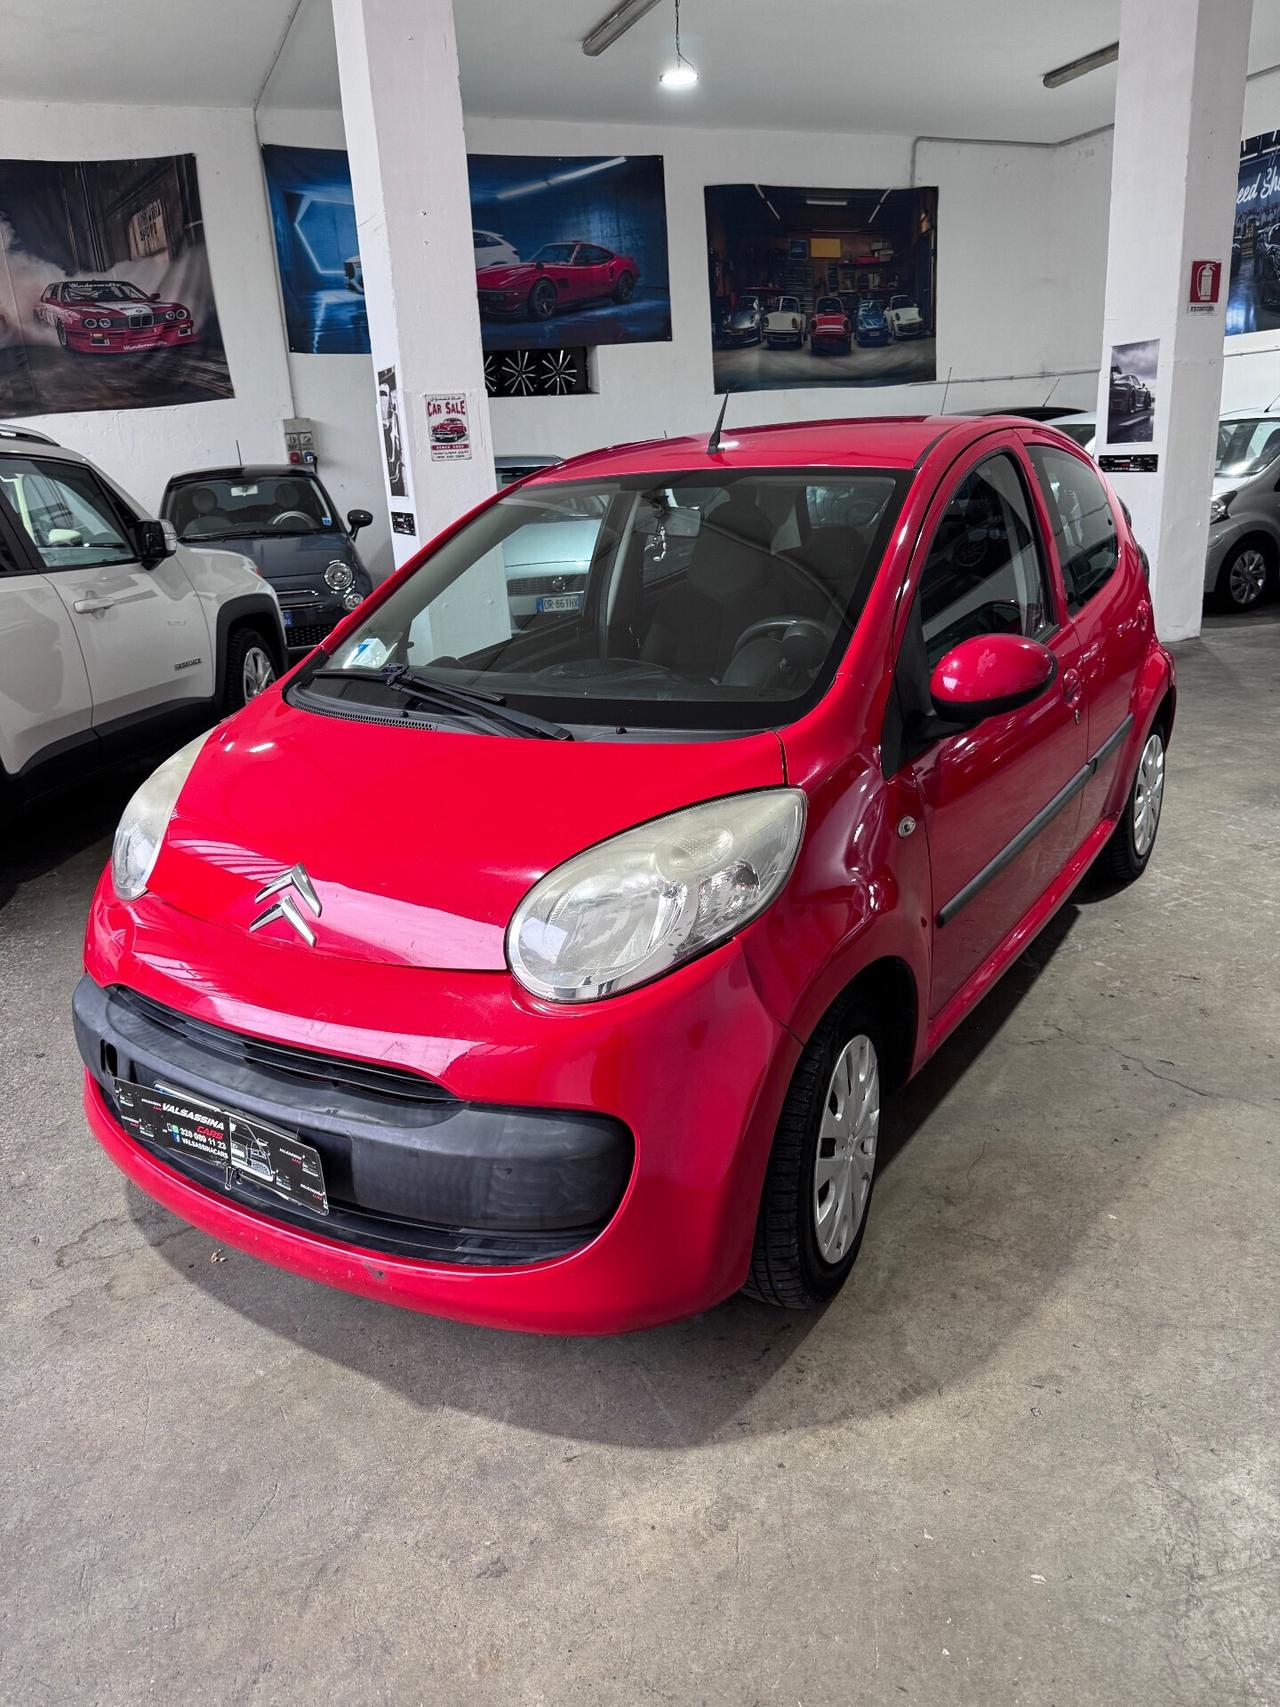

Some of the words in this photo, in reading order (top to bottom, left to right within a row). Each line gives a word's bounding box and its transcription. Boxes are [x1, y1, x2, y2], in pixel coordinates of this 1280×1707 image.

[427, 401, 442, 417] CAR
[445, 399, 466, 415] SALE
[162, 1103, 225, 1131] VALSASSINA
[196, 1125, 224, 1140] CARS
